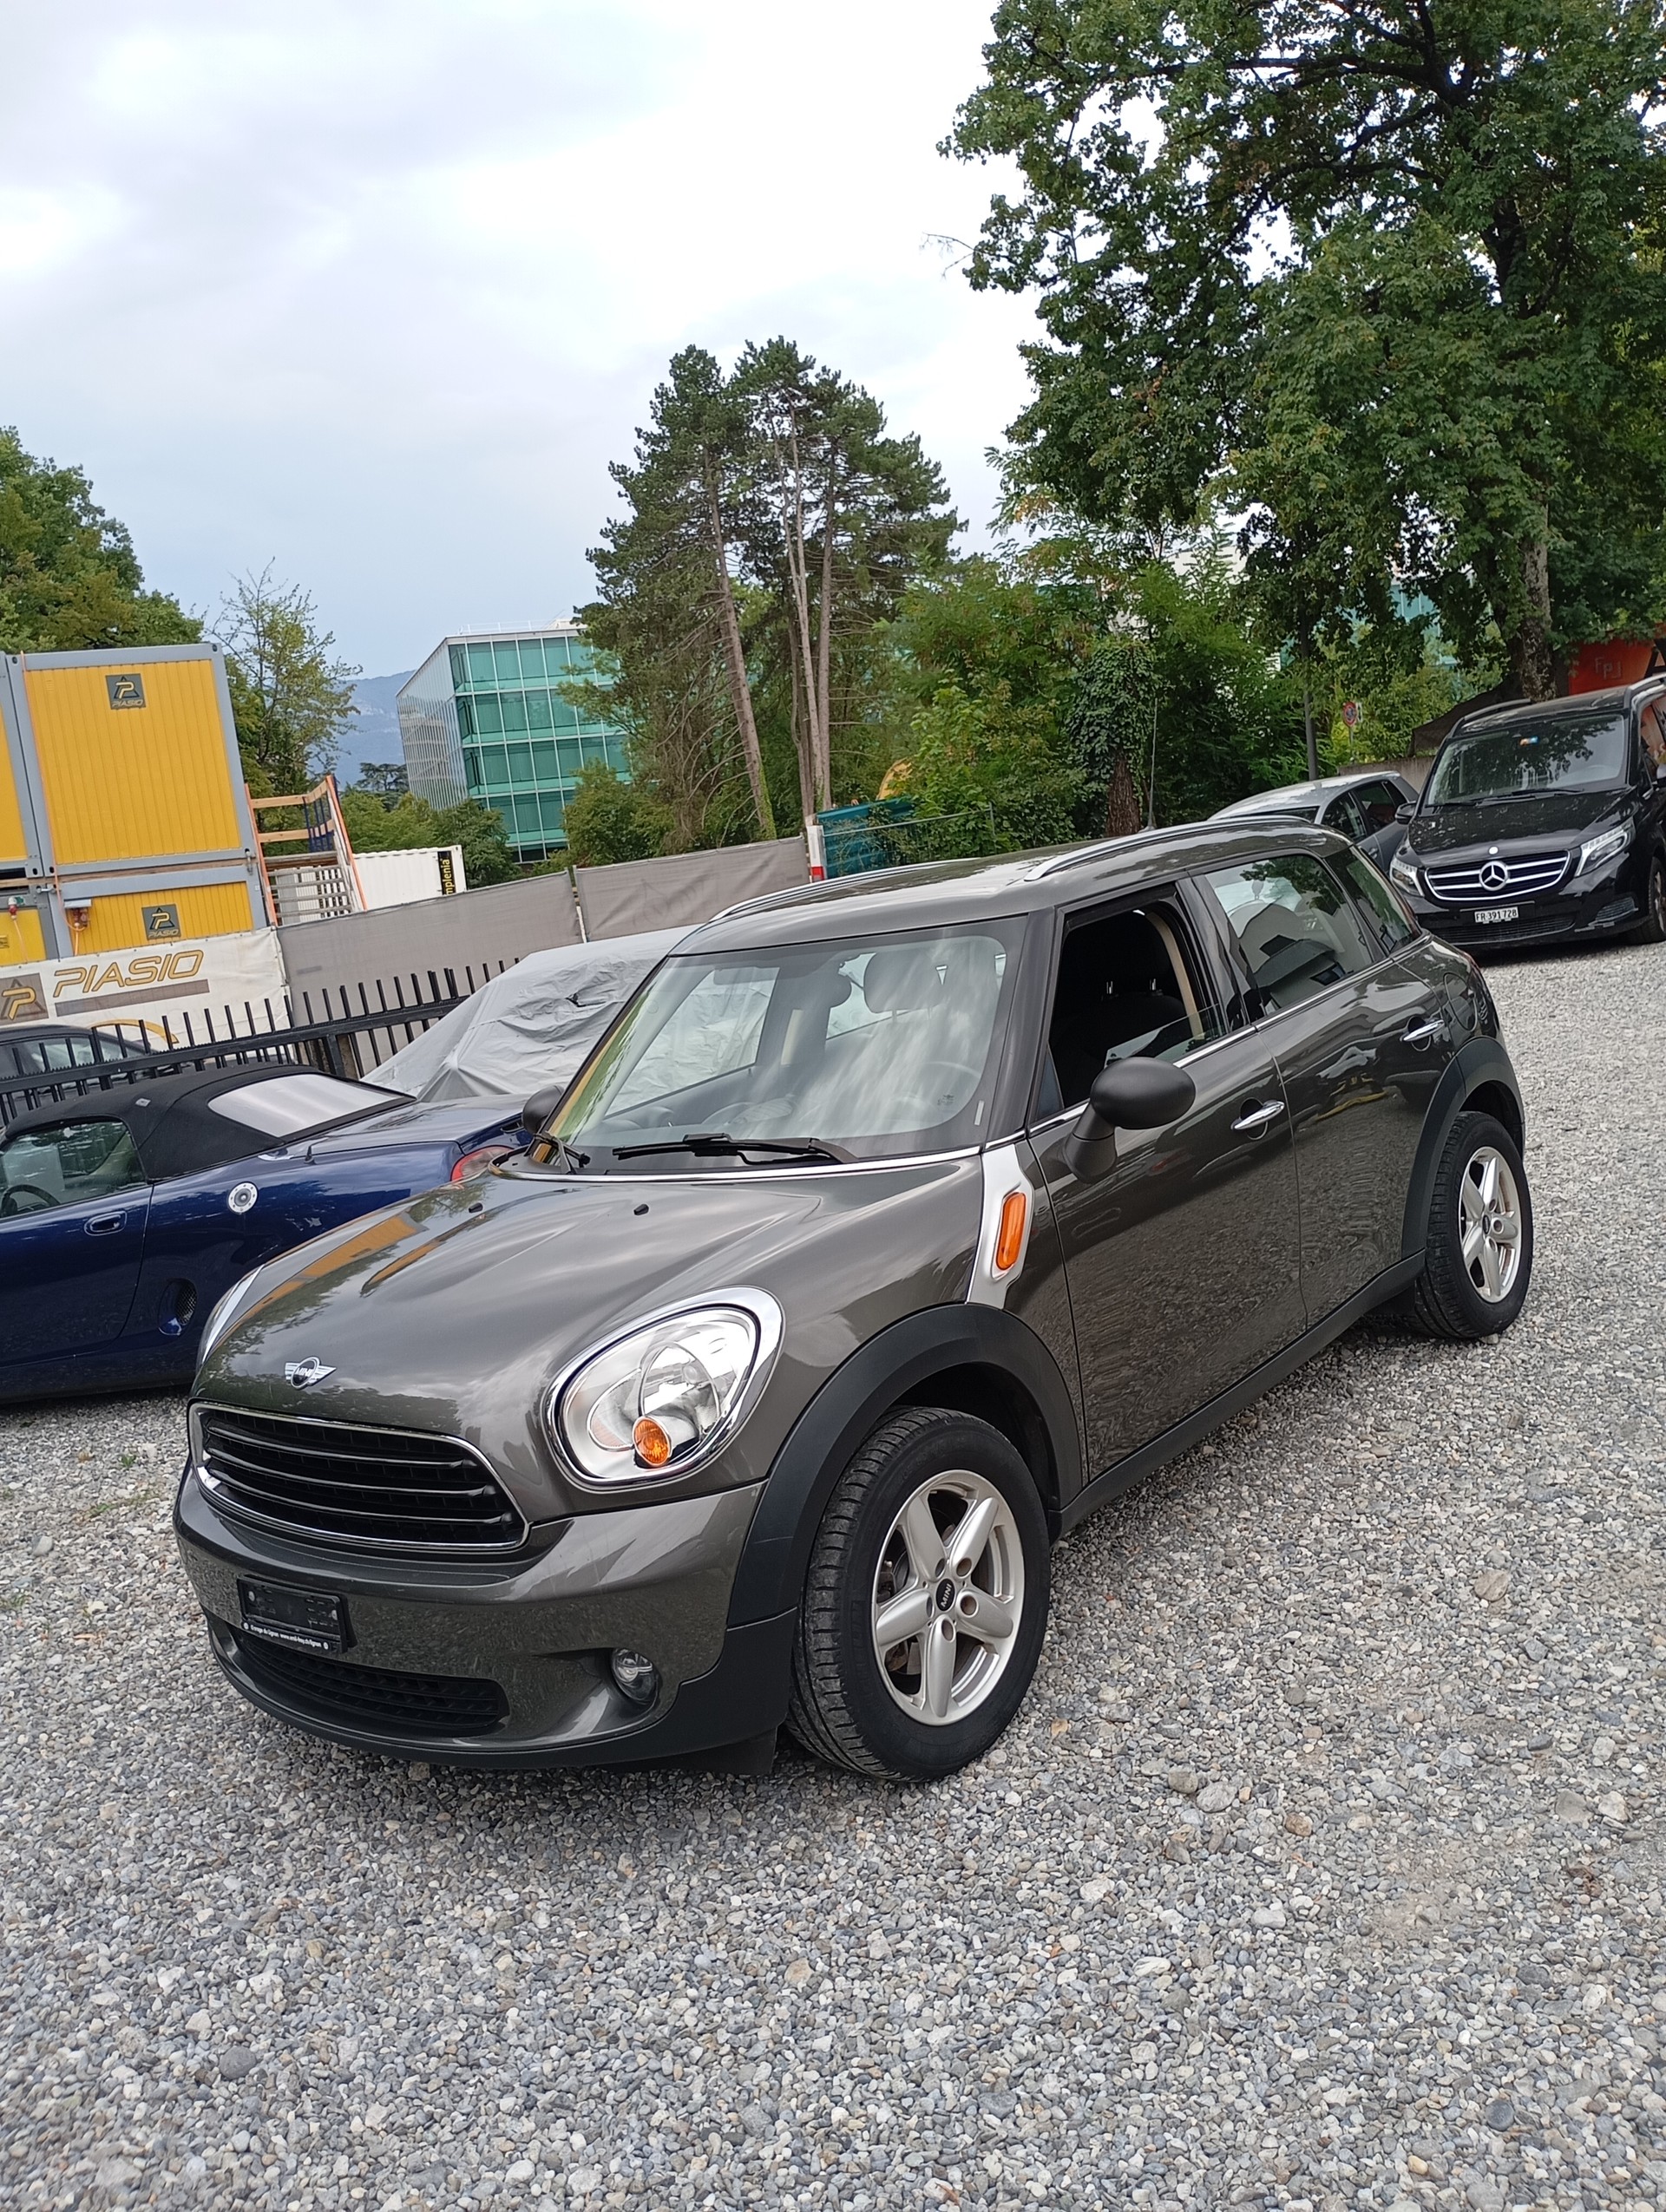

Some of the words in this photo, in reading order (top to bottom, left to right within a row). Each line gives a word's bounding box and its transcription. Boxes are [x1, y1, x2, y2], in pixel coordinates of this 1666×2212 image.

[112, 699, 143, 708] PIASIO
[53, 949, 204, 998] PIASIO
[294, 1367, 315, 1377] MINI
[941, 1583, 952, 1607] MINI
